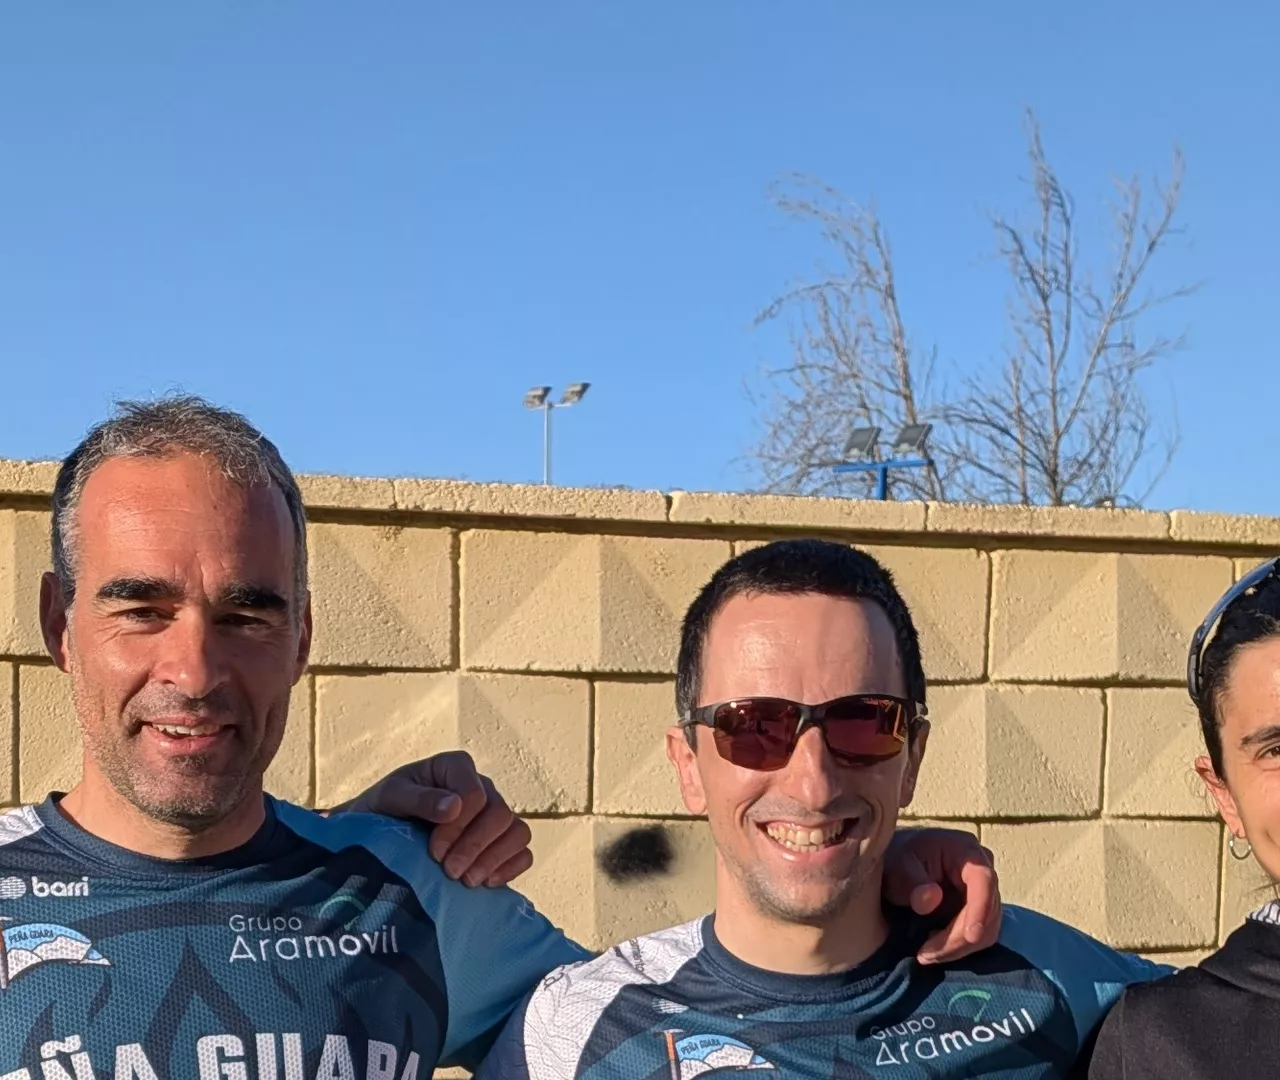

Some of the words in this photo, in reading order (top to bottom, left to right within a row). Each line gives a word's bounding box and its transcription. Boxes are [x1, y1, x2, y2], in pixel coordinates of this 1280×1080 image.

[31, 876, 89, 897] barri
[229, 913, 303, 935] Grupo
[229, 924, 399, 964] Aramovil
[870, 1015, 936, 1041] Grupo
[875, 1007, 1036, 1067] Aramovil
